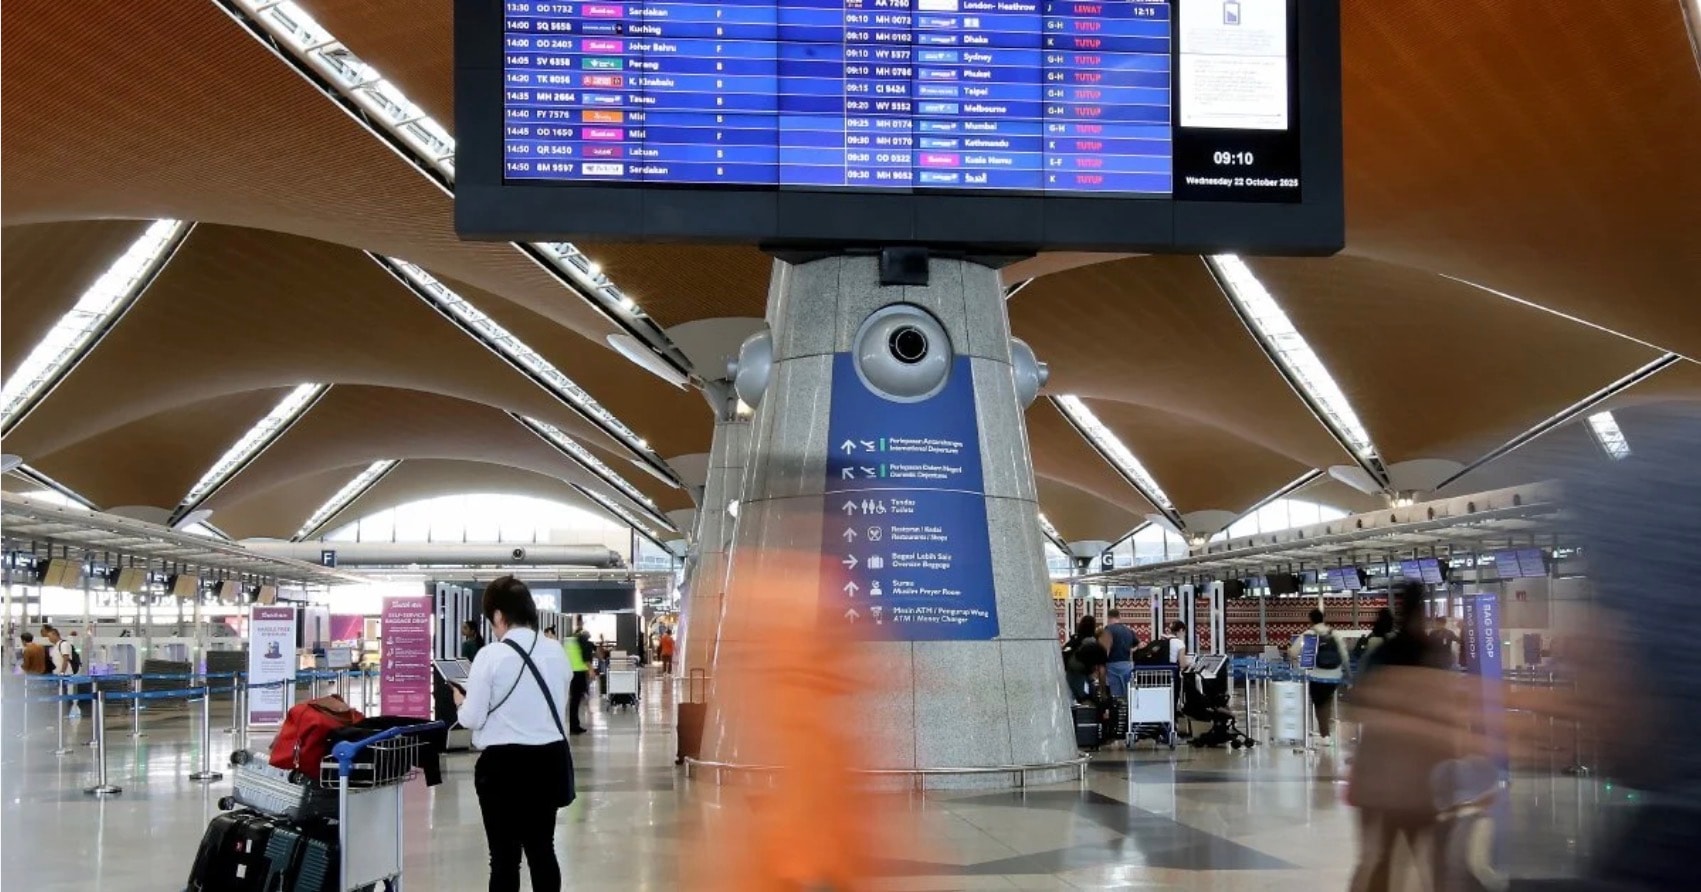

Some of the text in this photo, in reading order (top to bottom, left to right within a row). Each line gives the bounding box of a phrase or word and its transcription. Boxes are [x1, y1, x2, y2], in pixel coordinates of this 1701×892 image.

[1075, 22, 1100, 30] TUTUP
[1076, 125, 1102, 133] TUTUP
[1076, 142, 1102, 150] TUTUP
[1214, 151, 1253, 165] 09:10
[1077, 159, 1102, 167] TUTUP
[1077, 176, 1102, 184] TUTUP
[1186, 176, 1298, 187] Wednesday 22 October 2025
[324, 553, 332, 564] F
[1103, 555, 1113, 565] G
[942, 616, 968, 624] Changer
[1483, 604, 1494, 658] BAG DROP
